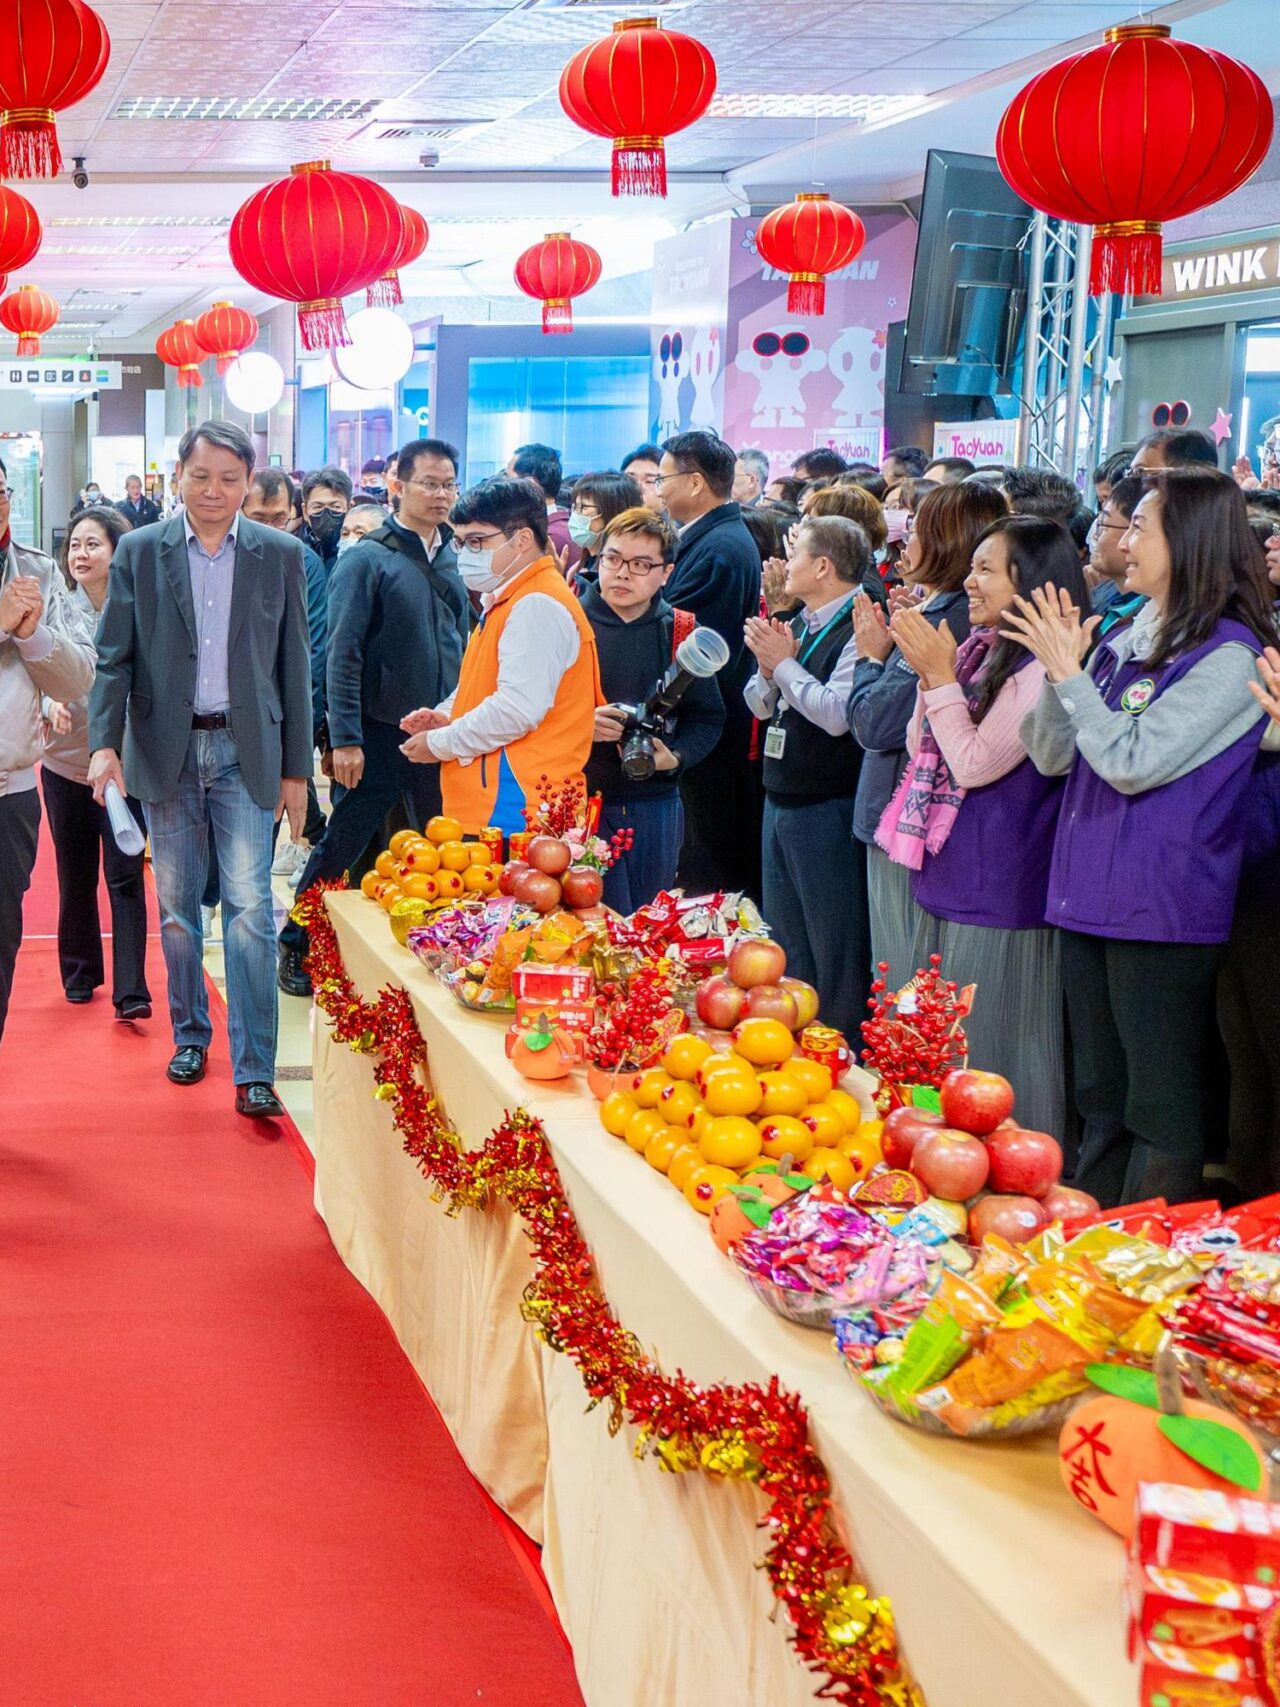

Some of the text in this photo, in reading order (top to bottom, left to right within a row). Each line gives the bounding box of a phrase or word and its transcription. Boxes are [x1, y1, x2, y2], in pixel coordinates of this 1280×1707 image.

[1172, 247, 1268, 292] WINK
[951, 435, 1003, 459] TaoYuan
[1061, 1421, 1118, 1511] 大吉
